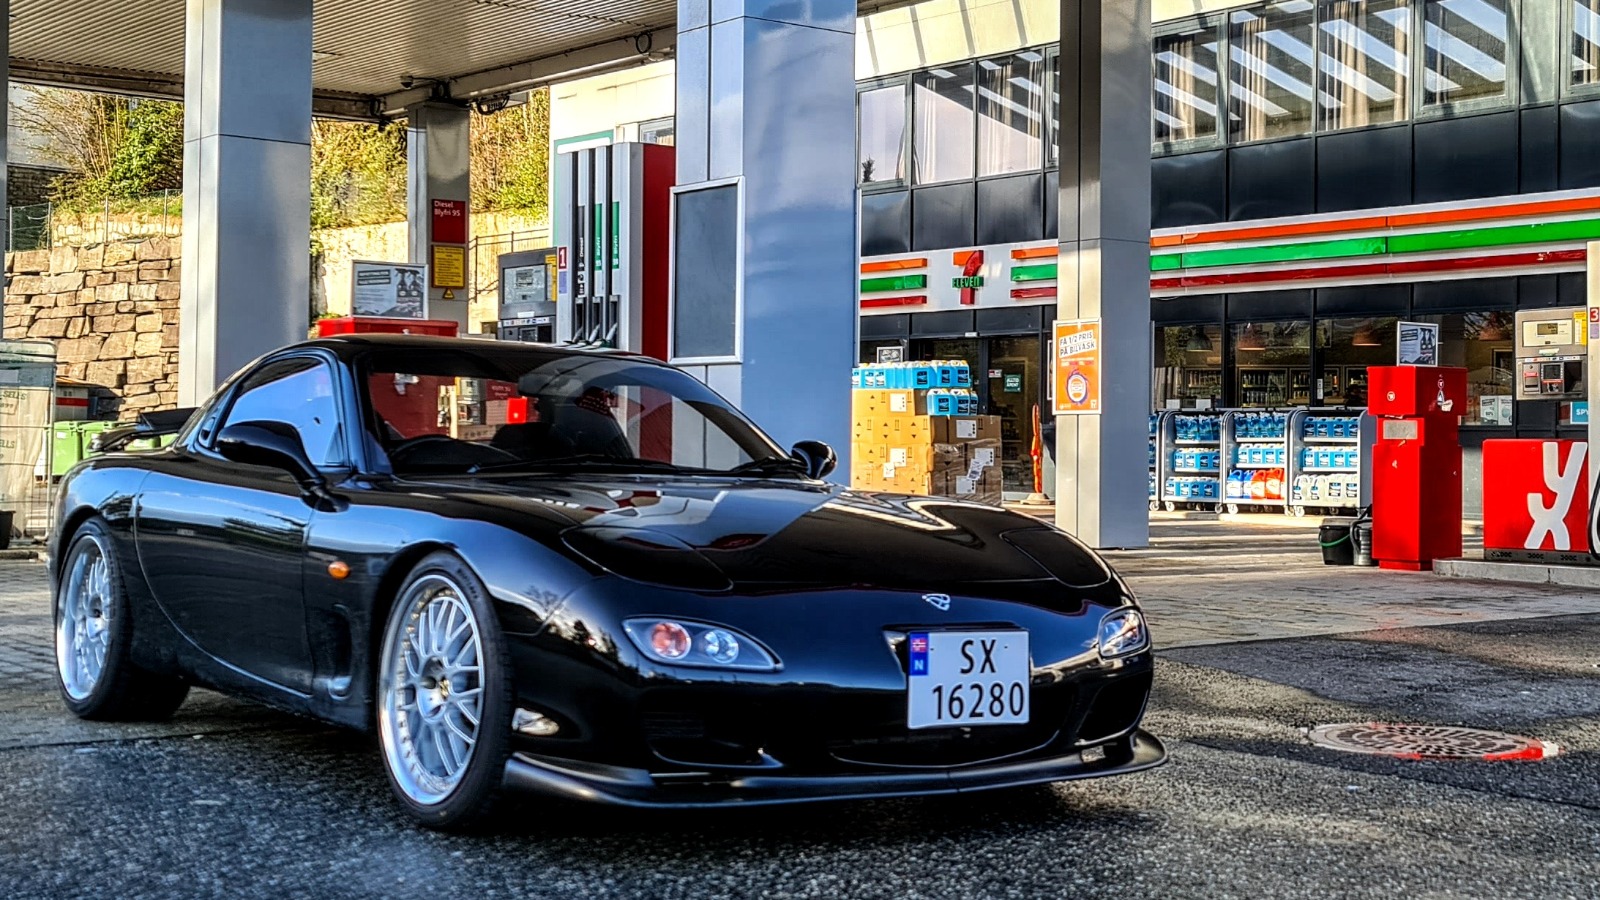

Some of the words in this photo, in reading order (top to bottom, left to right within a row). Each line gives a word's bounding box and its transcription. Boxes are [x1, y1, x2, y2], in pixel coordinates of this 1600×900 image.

[434, 200, 454, 208] Diesel
[434, 208, 451, 217] Blyfri
[452, 209, 461, 217] 95
[559, 248, 566, 267] 1
[953, 250, 984, 305] 7
[1590, 308, 1599, 321] 3
[1078, 332, 1092, 341] PRIS
[1069, 341, 1095, 354] BILVASK
[960, 639, 997, 674] SX
[914, 659, 924, 671] N
[932, 682, 1024, 720] 16280
